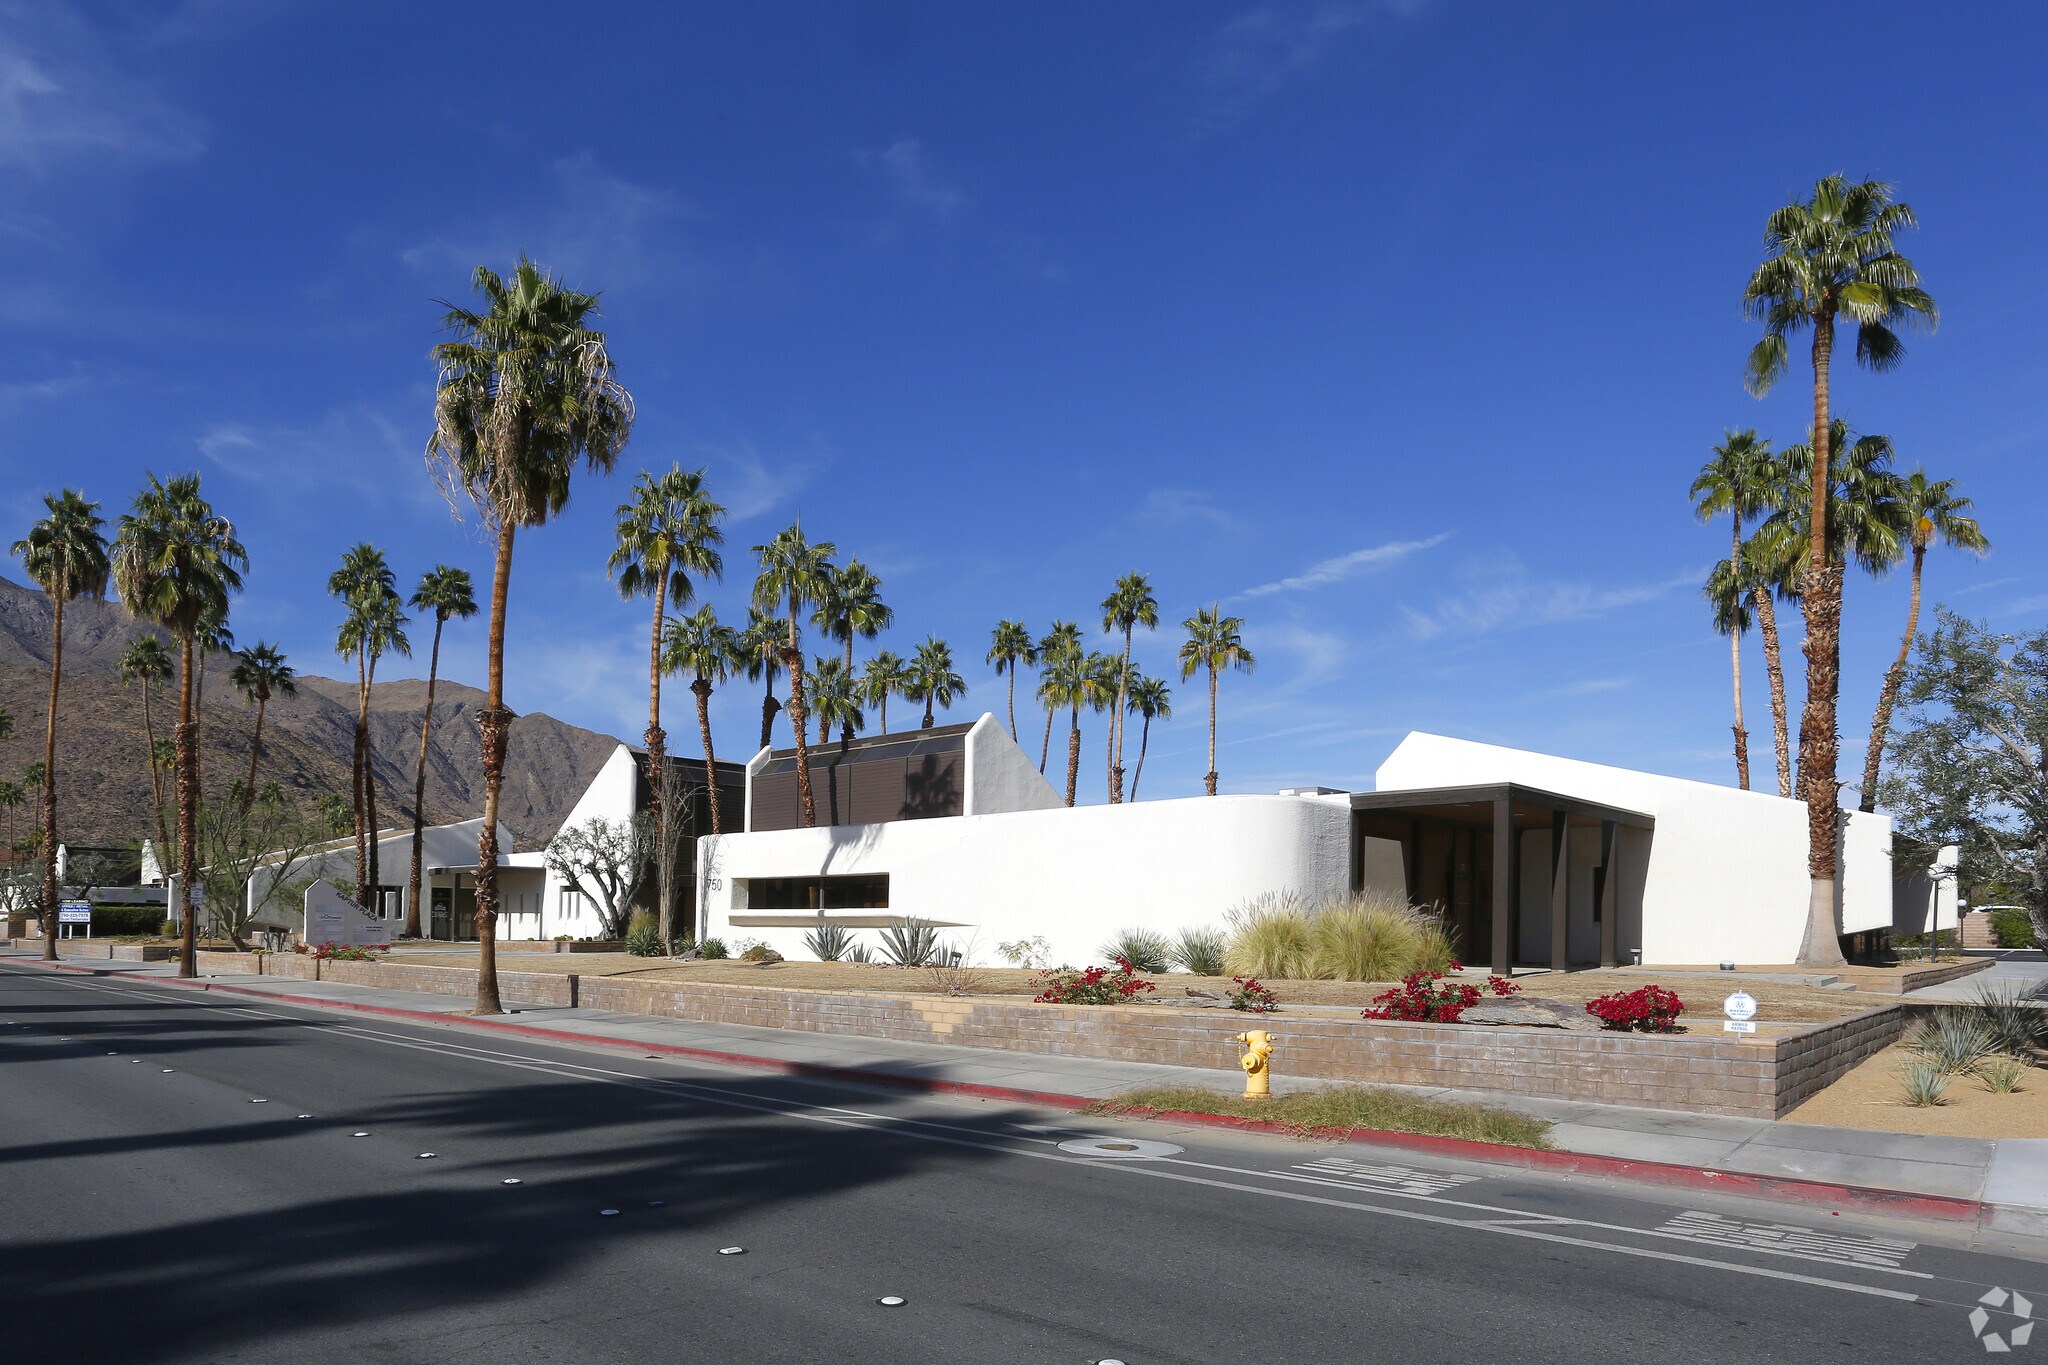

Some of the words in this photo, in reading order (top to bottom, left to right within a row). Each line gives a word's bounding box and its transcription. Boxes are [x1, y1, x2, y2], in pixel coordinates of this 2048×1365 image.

[707, 878, 722, 891] 750
[336, 891, 360, 910] KAPTUR
[359, 907, 378, 922] PLAZA
[1268, 1157, 1483, 1195] LANE
[1654, 1210, 1918, 1267] BIKE
